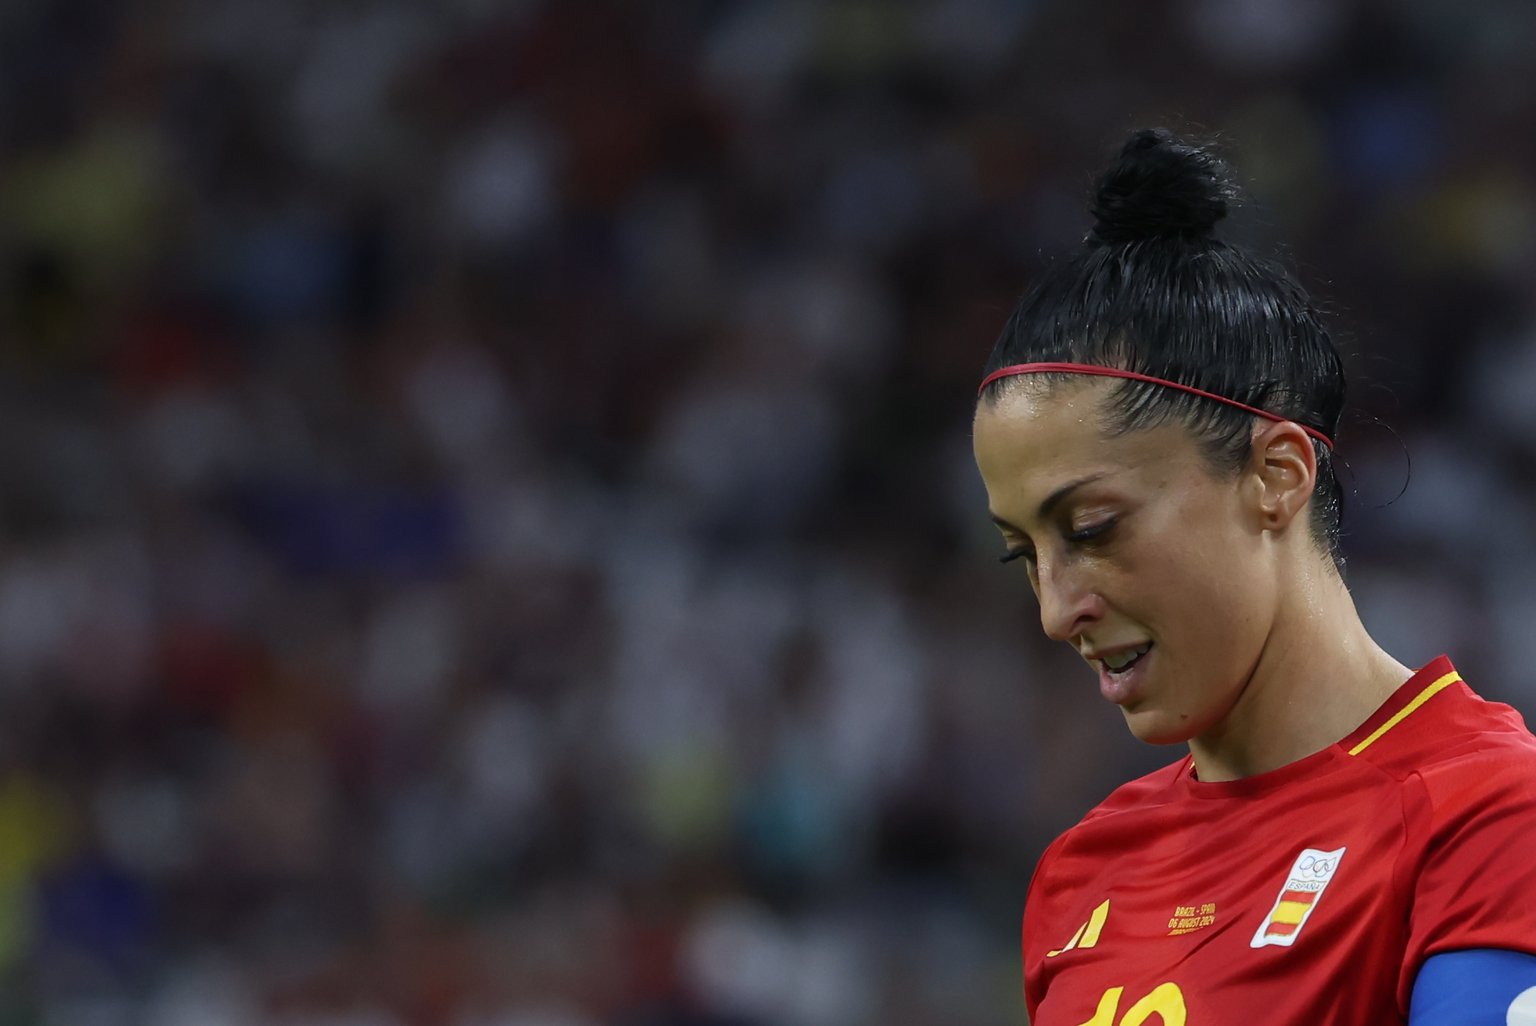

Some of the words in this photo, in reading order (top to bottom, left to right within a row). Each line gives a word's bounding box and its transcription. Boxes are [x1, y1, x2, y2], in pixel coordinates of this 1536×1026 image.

[1288, 881, 1322, 891] ESPAÑA
[1174, 906, 1196, 917] BRAZIL
[1200, 903, 1216, 915] SPAIN
[1168, 918, 1179, 928] 06
[1177, 917, 1201, 928] AUGUST
[1199, 915, 1216, 926] 2024
